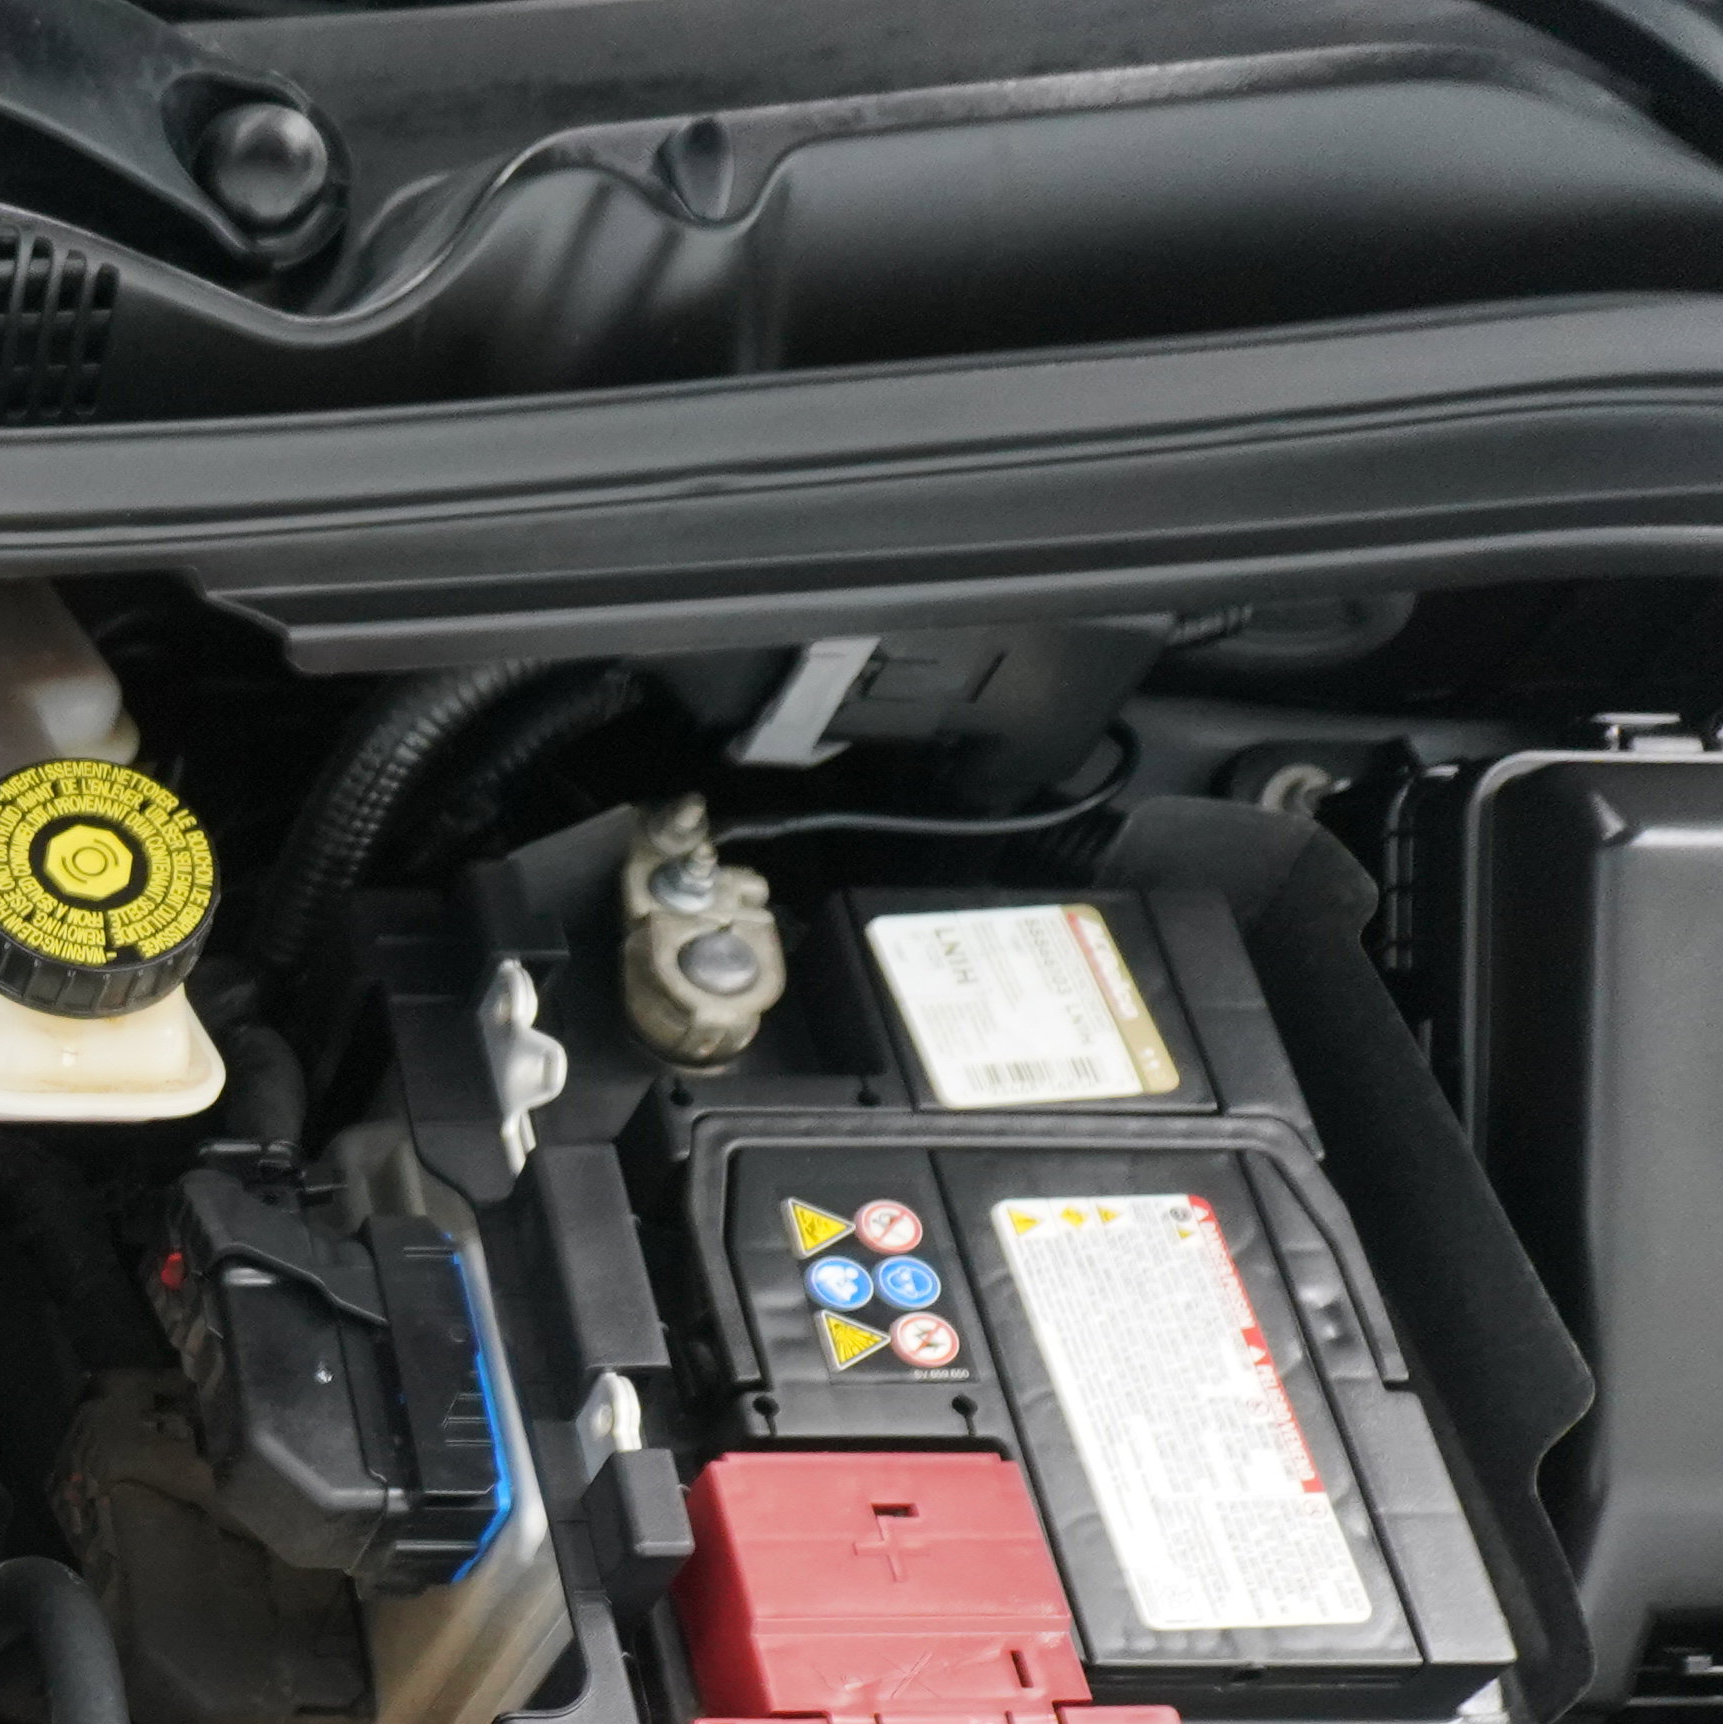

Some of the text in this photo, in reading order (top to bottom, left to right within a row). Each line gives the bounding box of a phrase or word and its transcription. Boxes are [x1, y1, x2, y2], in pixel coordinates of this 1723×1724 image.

[17, 783, 55, 809] AVANT
[60, 780, 78, 793] DE
[55, 797, 129, 820] PROVENANT
[173, 809, 197, 830] LE
[144, 805, 186, 848] UTILISER
[186, 830, 213, 886] BOUCHON
[4, 890, 33, 918] USE
[192, 887, 211, 907] DE
[54, 905, 67, 919] A
[67, 911, 104, 927] FROM
[154, 905, 175, 924] DU
[114, 917, 163, 945] LIQUIDE
